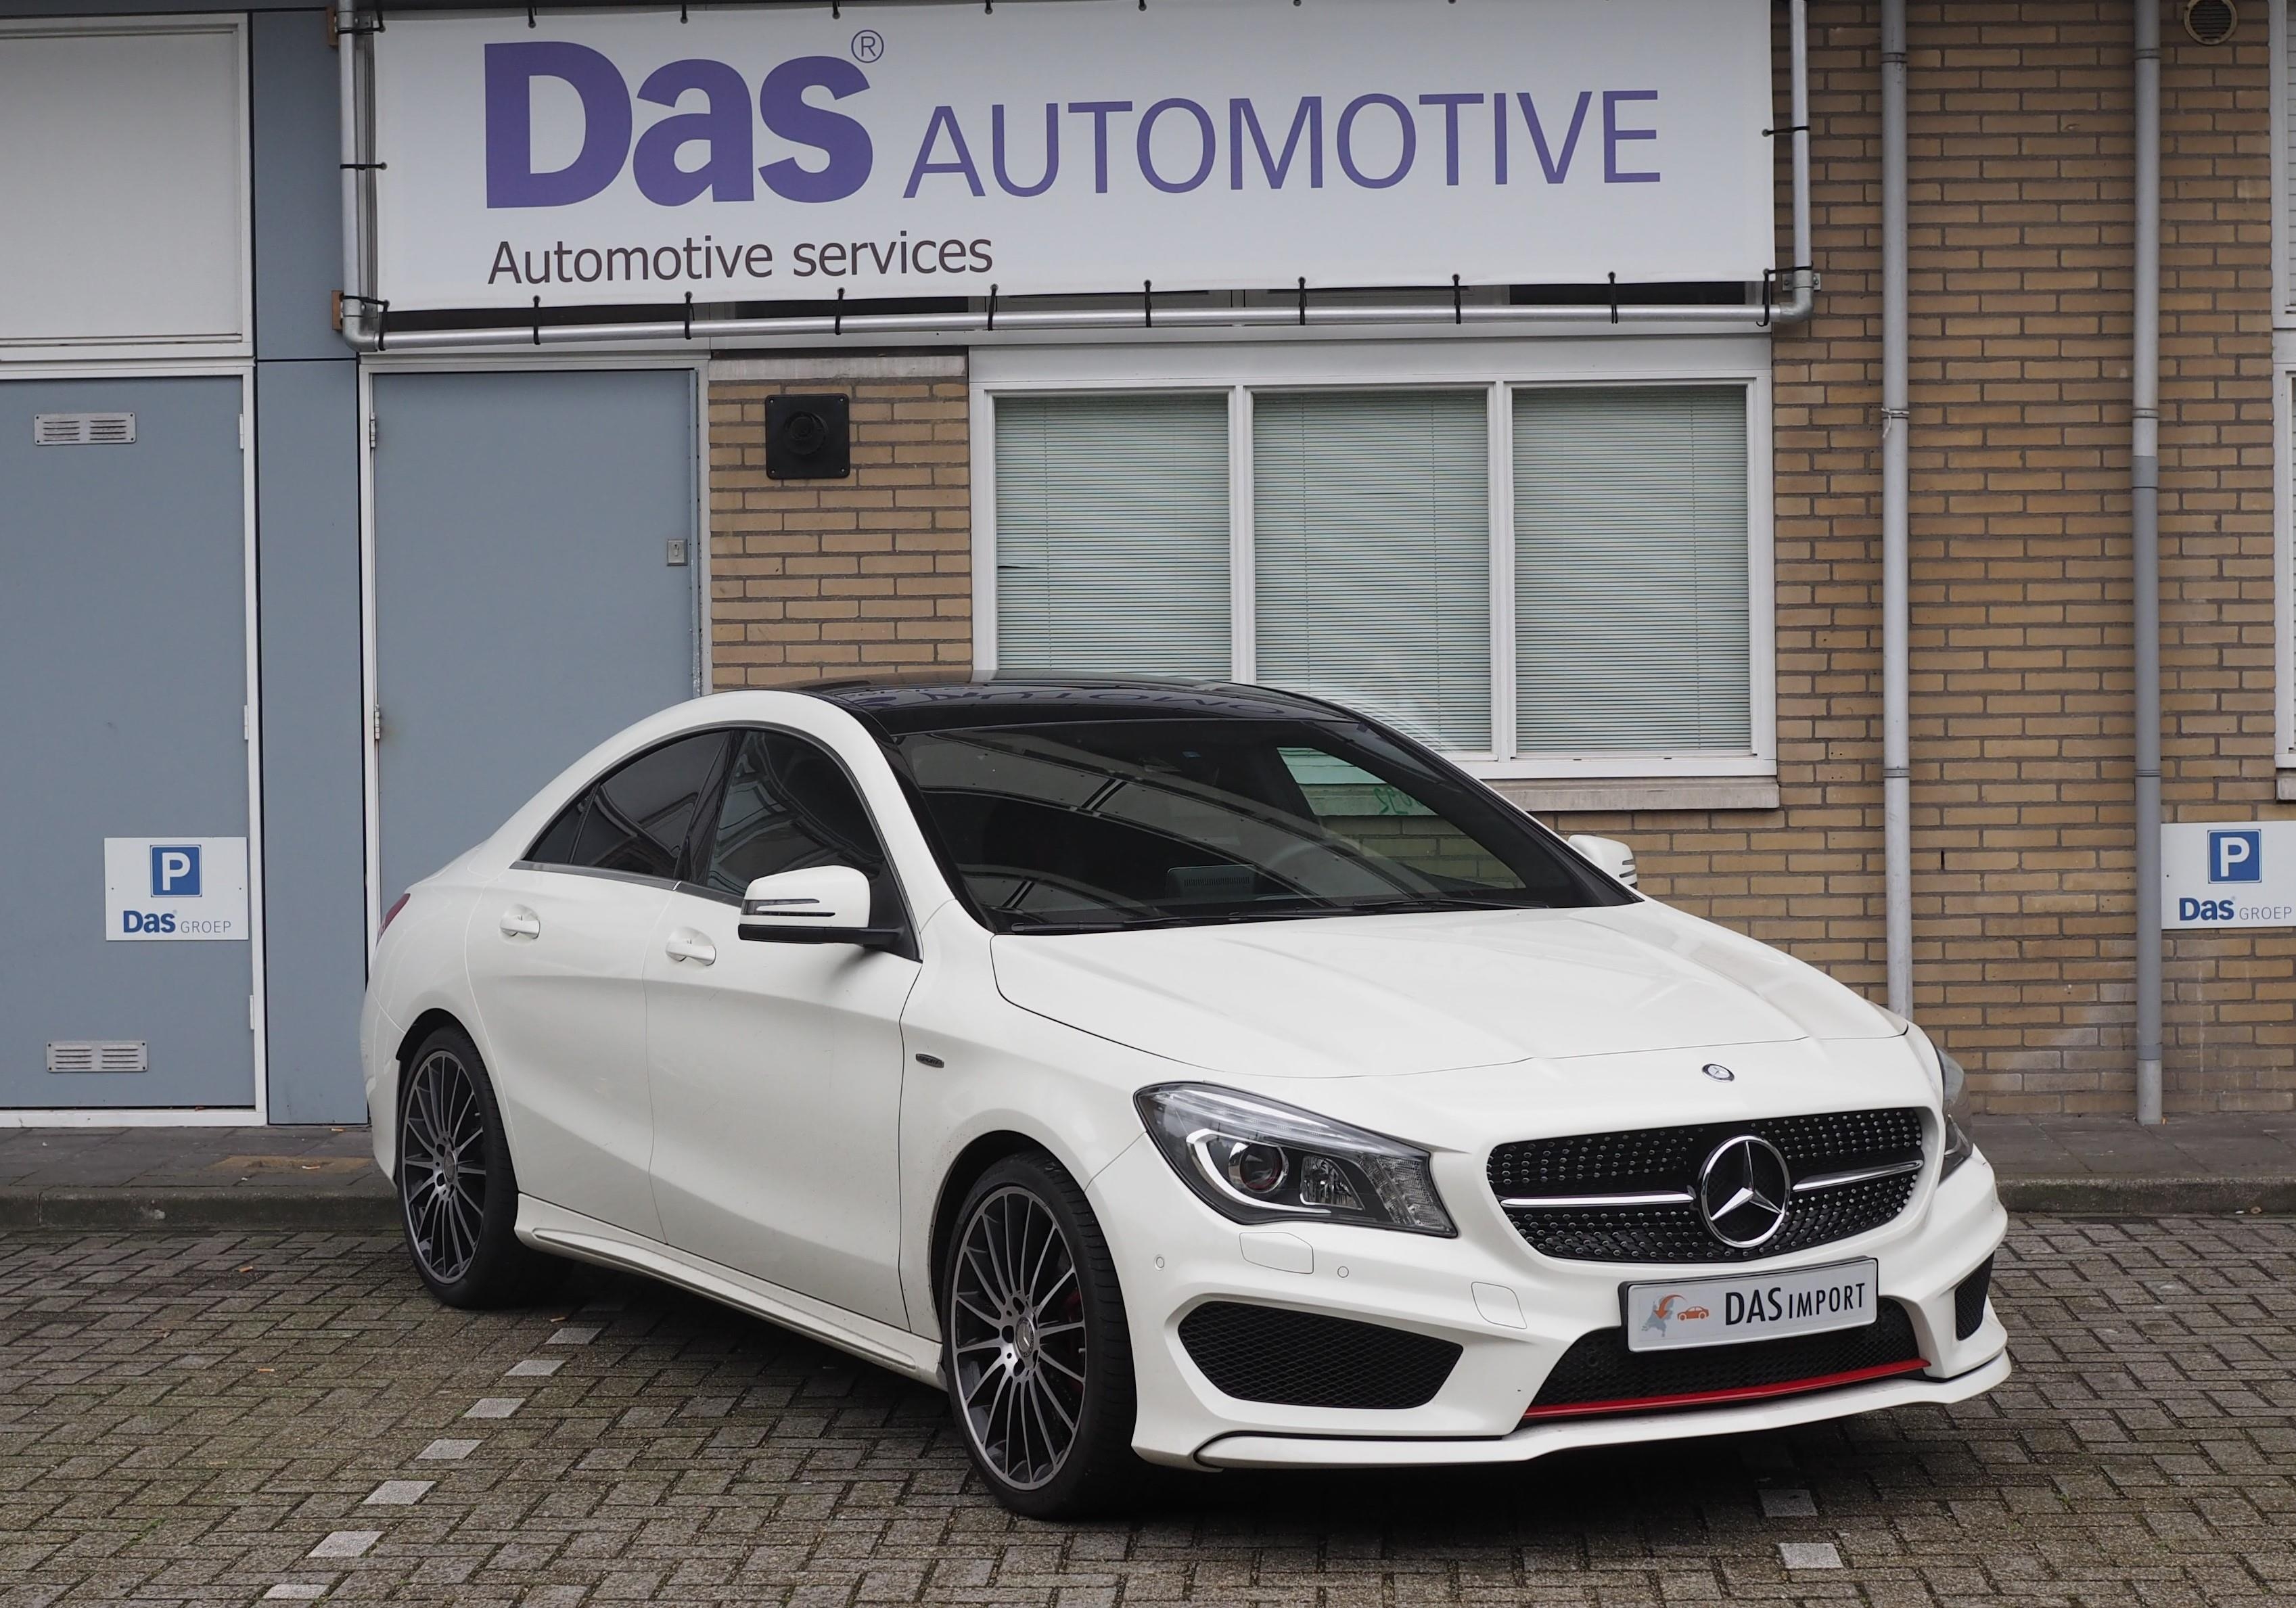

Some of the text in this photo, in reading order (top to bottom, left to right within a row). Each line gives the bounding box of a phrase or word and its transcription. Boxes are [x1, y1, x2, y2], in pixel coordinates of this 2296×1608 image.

[903, 90, 1660, 198] AUTOMOTIVE
[488, 231, 992, 284] Automotive services
[162, 852, 190, 891] P
[2221, 837, 2250, 877] P
[181, 921, 231, 933] GROEP
[2239, 906, 2292, 920] GROEP
[1726, 1283, 1865, 1325] DAS IMPORT
